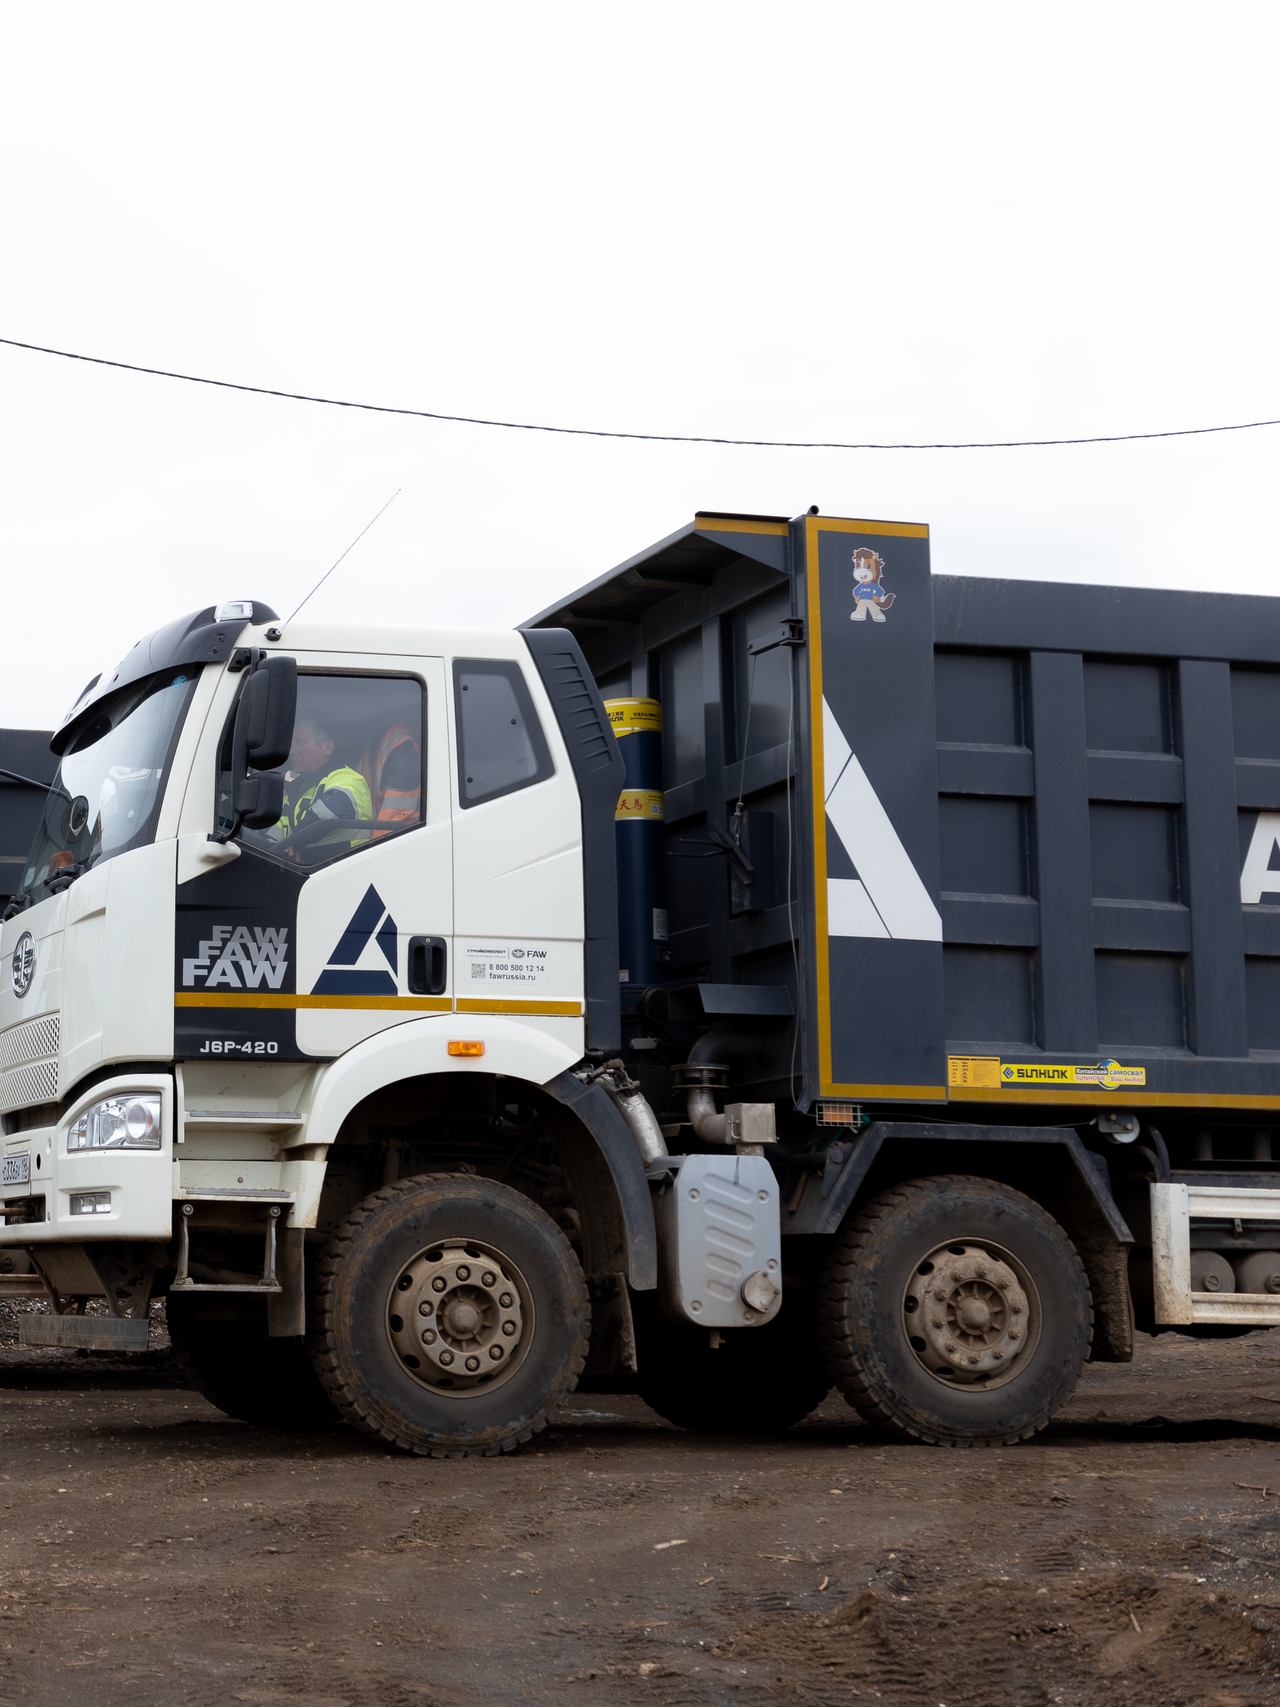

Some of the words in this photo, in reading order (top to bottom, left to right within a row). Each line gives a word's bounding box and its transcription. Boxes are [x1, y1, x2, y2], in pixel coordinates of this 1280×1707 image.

[213, 925, 288, 948] FAW
[199, 940, 288, 966] FAW
[527, 950, 547, 958] FAW
[182, 958, 288, 988] FAW
[489, 972, 536, 980] fawrussia.ru
[200, 1040, 278, 1054] J6P-420
[1017, 1068, 1068, 1079] SUNHUNK
